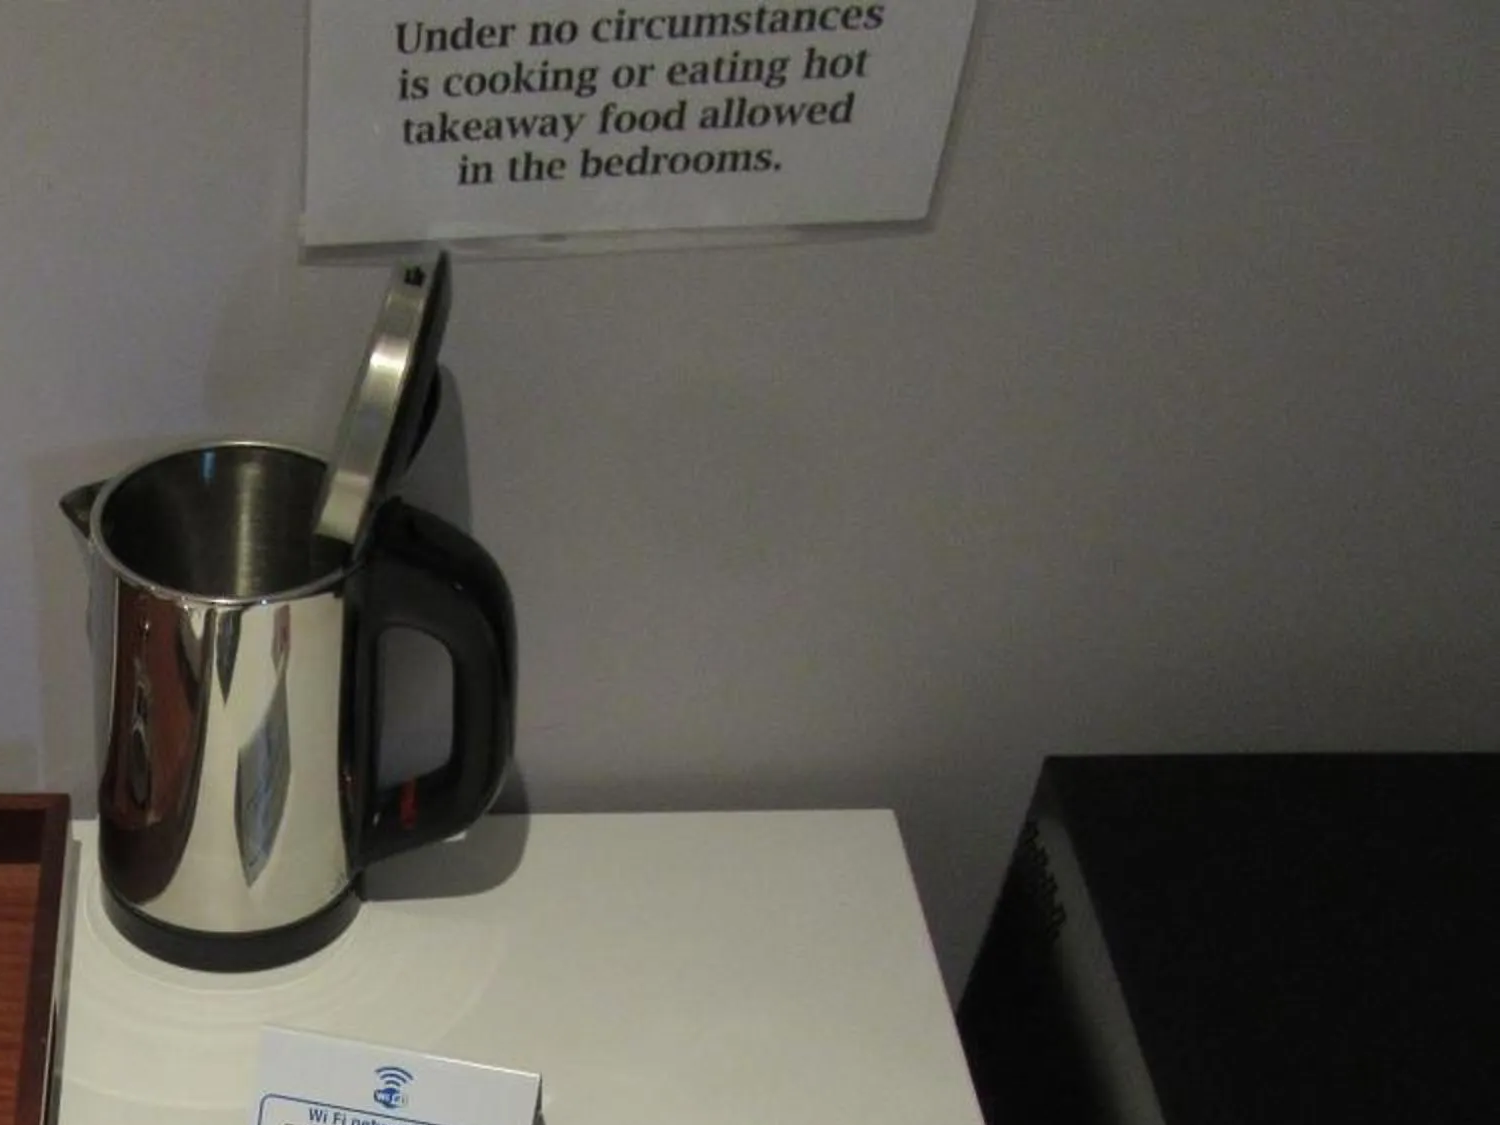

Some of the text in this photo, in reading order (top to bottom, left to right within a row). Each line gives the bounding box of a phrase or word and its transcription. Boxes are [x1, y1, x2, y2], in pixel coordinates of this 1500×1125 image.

[395, 2, 885, 56] Under no circumstances
[399, 47, 871, 100] is cooking or eating hot
[403, 93, 856, 146] takeaway food allowed
[457, 144, 782, 186] in the bedrooms.
[333, 1111, 347, 1125] Fi
